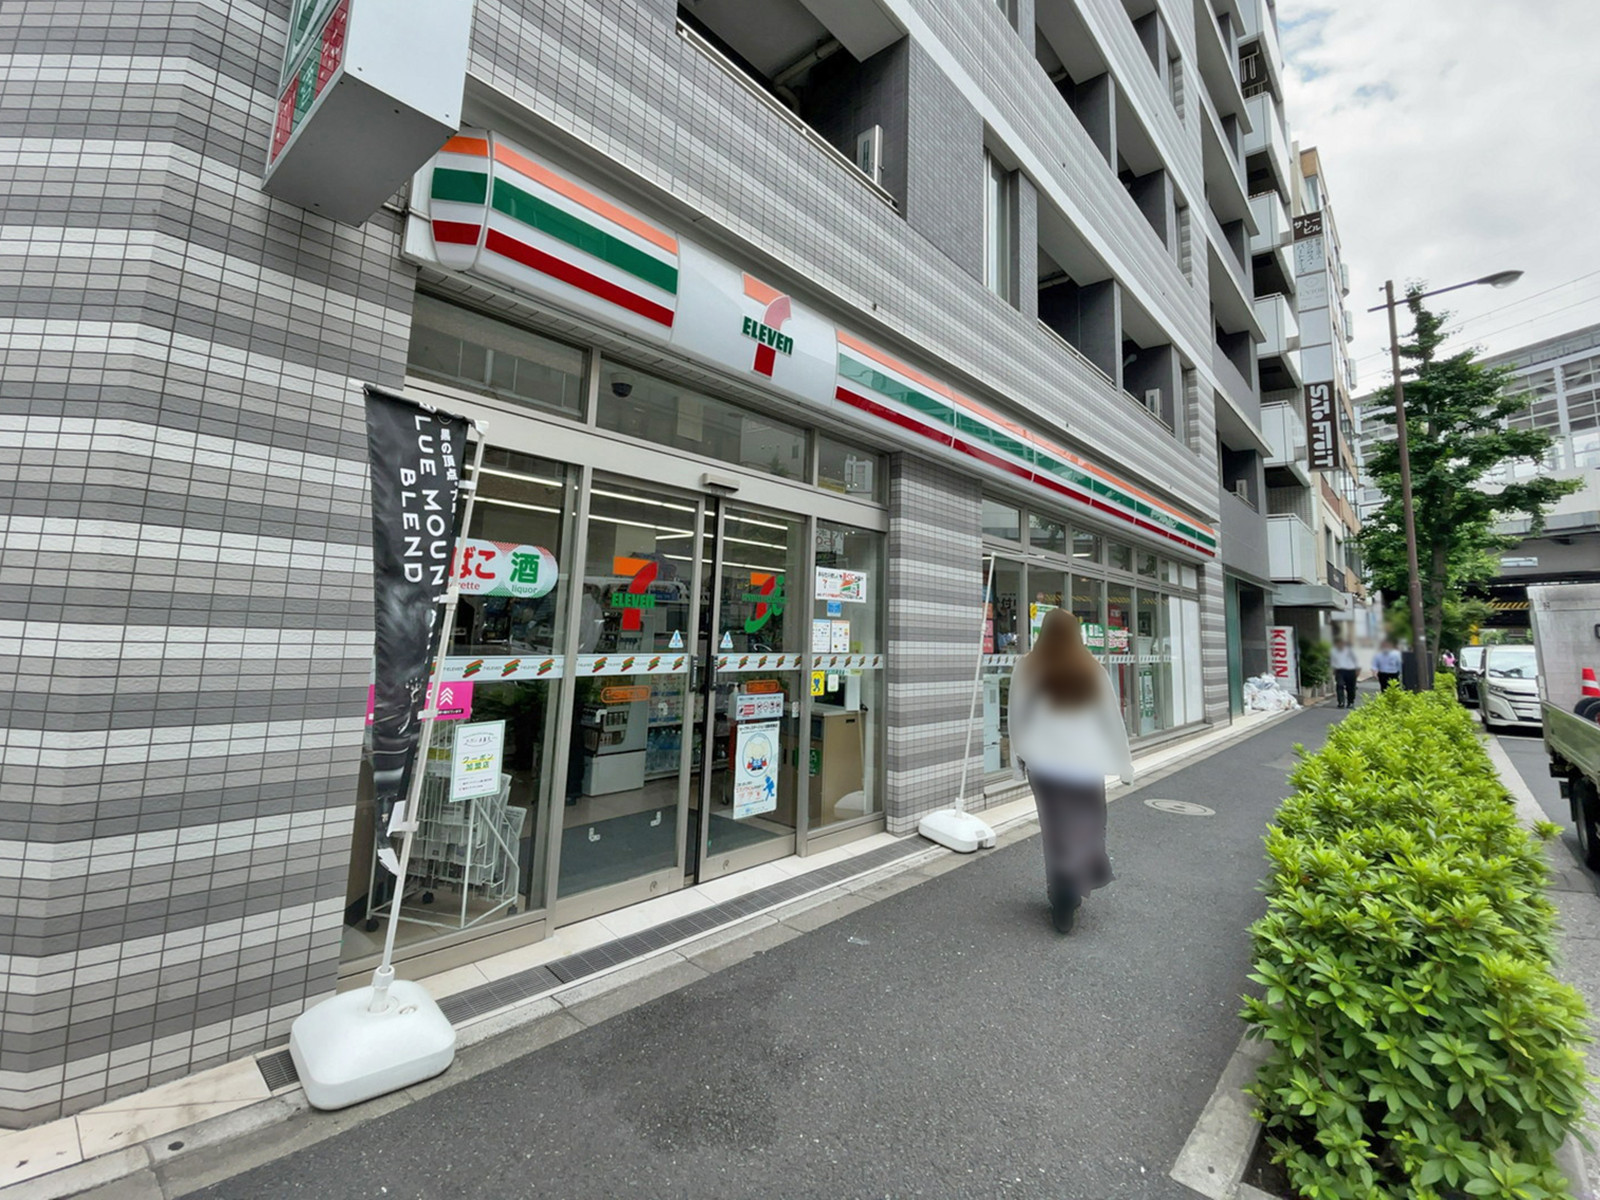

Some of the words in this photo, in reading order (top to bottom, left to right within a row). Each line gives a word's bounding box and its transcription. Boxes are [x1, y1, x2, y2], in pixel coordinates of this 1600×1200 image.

[1294, 217, 1320, 229] サトー
[1303, 224, 1321, 235] ビル
[400, 467, 423, 583] BLEND
[509, 551, 540, 584] 酒
[511, 584, 538, 594] liquor
[1270, 629, 1289, 678] KIRIN
